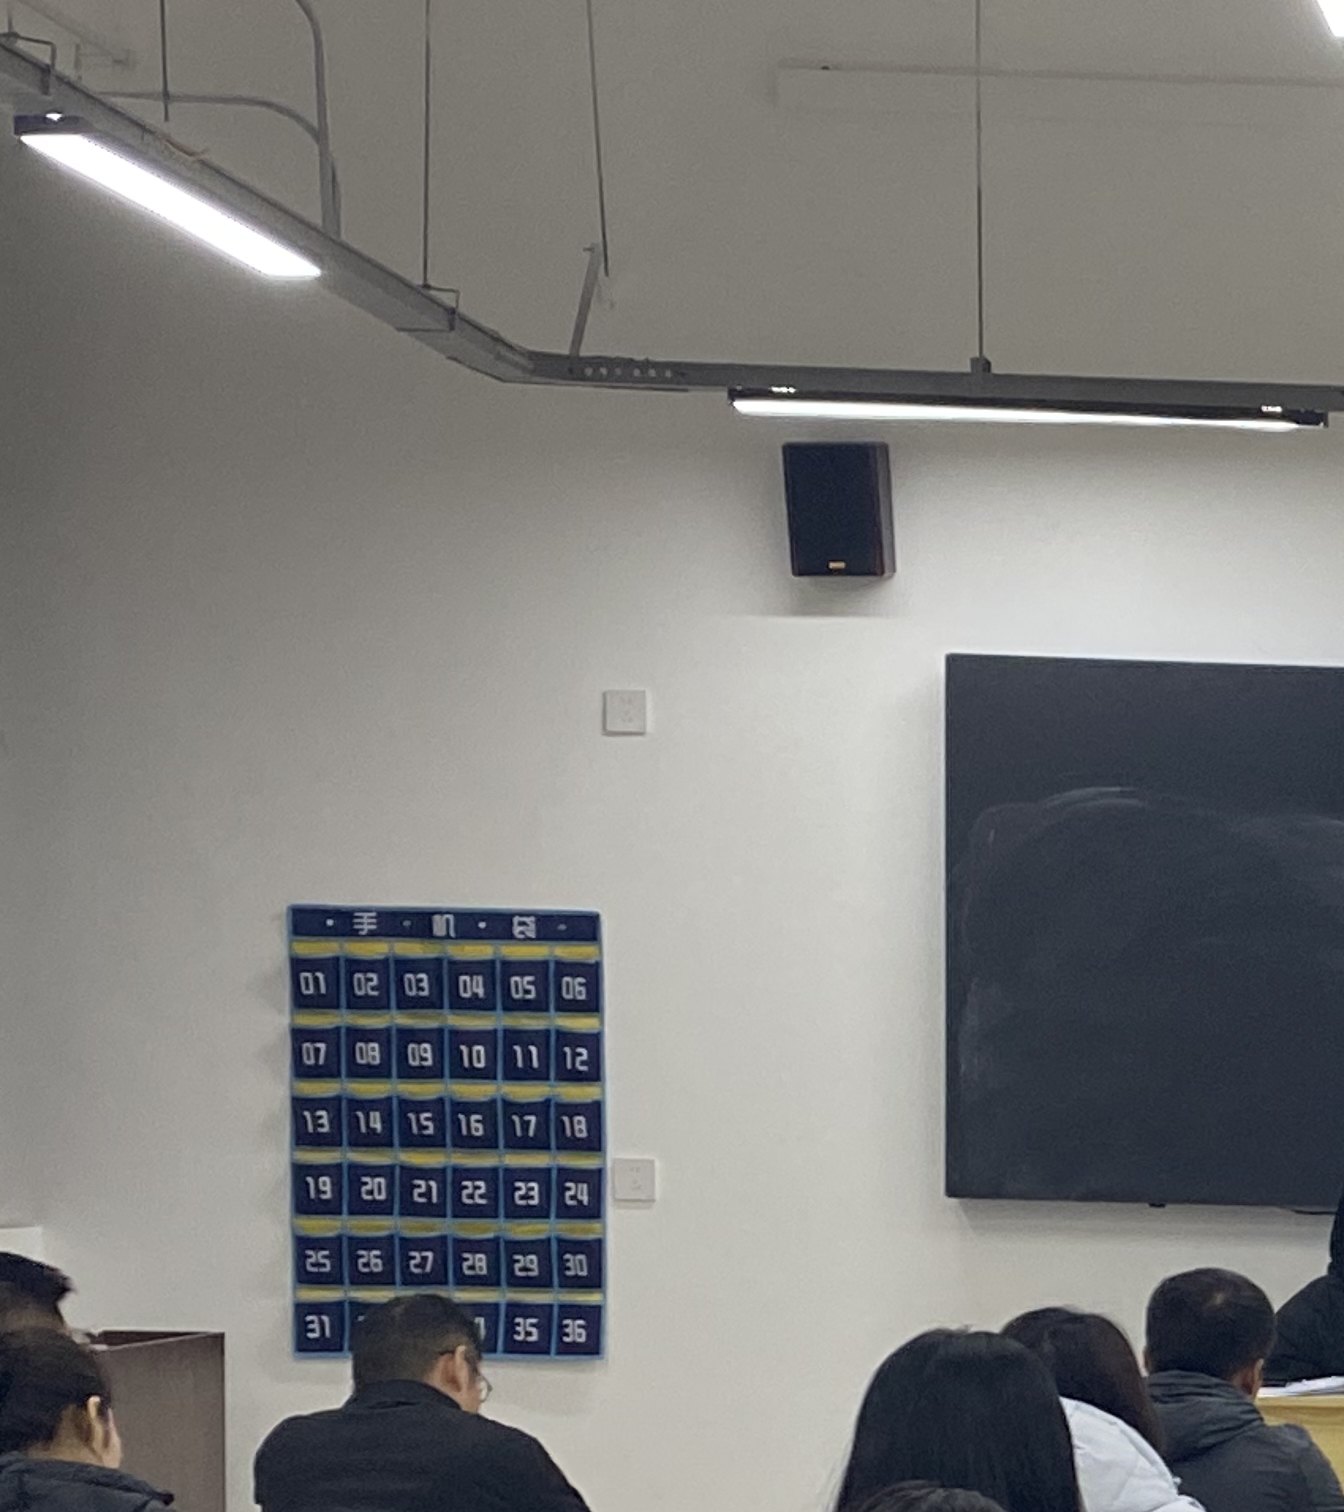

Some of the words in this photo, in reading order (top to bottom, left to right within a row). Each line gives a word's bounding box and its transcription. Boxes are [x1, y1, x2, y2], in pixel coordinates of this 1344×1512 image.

[299, 971, 326, 995] 01
[353, 972, 380, 996] 02
[403, 972, 430, 997] 03
[458, 975, 485, 998] 04
[510, 975, 536, 999] 05
[562, 976, 587, 1000] 06
[302, 1042, 327, 1065] 07
[355, 1041, 381, 1065] 08
[407, 1042, 433, 1067] 09
[459, 1044, 486, 1069] 10
[513, 1045, 539, 1069] 11
[563, 1046, 589, 1071] 12
[303, 1110, 330, 1133] 13
[355, 1111, 382, 1134] 14
[407, 1112, 434, 1135] 15
[458, 1113, 484, 1137] 16
[511, 1114, 537, 1137] 17
[561, 1115, 588, 1138] 18
[306, 1176, 332, 1200] 19
[361, 1176, 387, 1201] 20
[413, 1179, 438, 1204] 21
[461, 1180, 488, 1205] 22
[514, 1181, 540, 1206] 23
[564, 1181, 589, 1206] 24
[304, 1249, 331, 1273] 25
[356, 1249, 383, 1273] 26
[408, 1251, 434, 1274] 27
[462, 1252, 488, 1275] 28
[513, 1254, 539, 1277] 29
[563, 1253, 588, 1277] 30
[305, 1315, 331, 1339] 31
[513, 1317, 539, 1342] 35
[562, 1318, 587, 1343] 36
